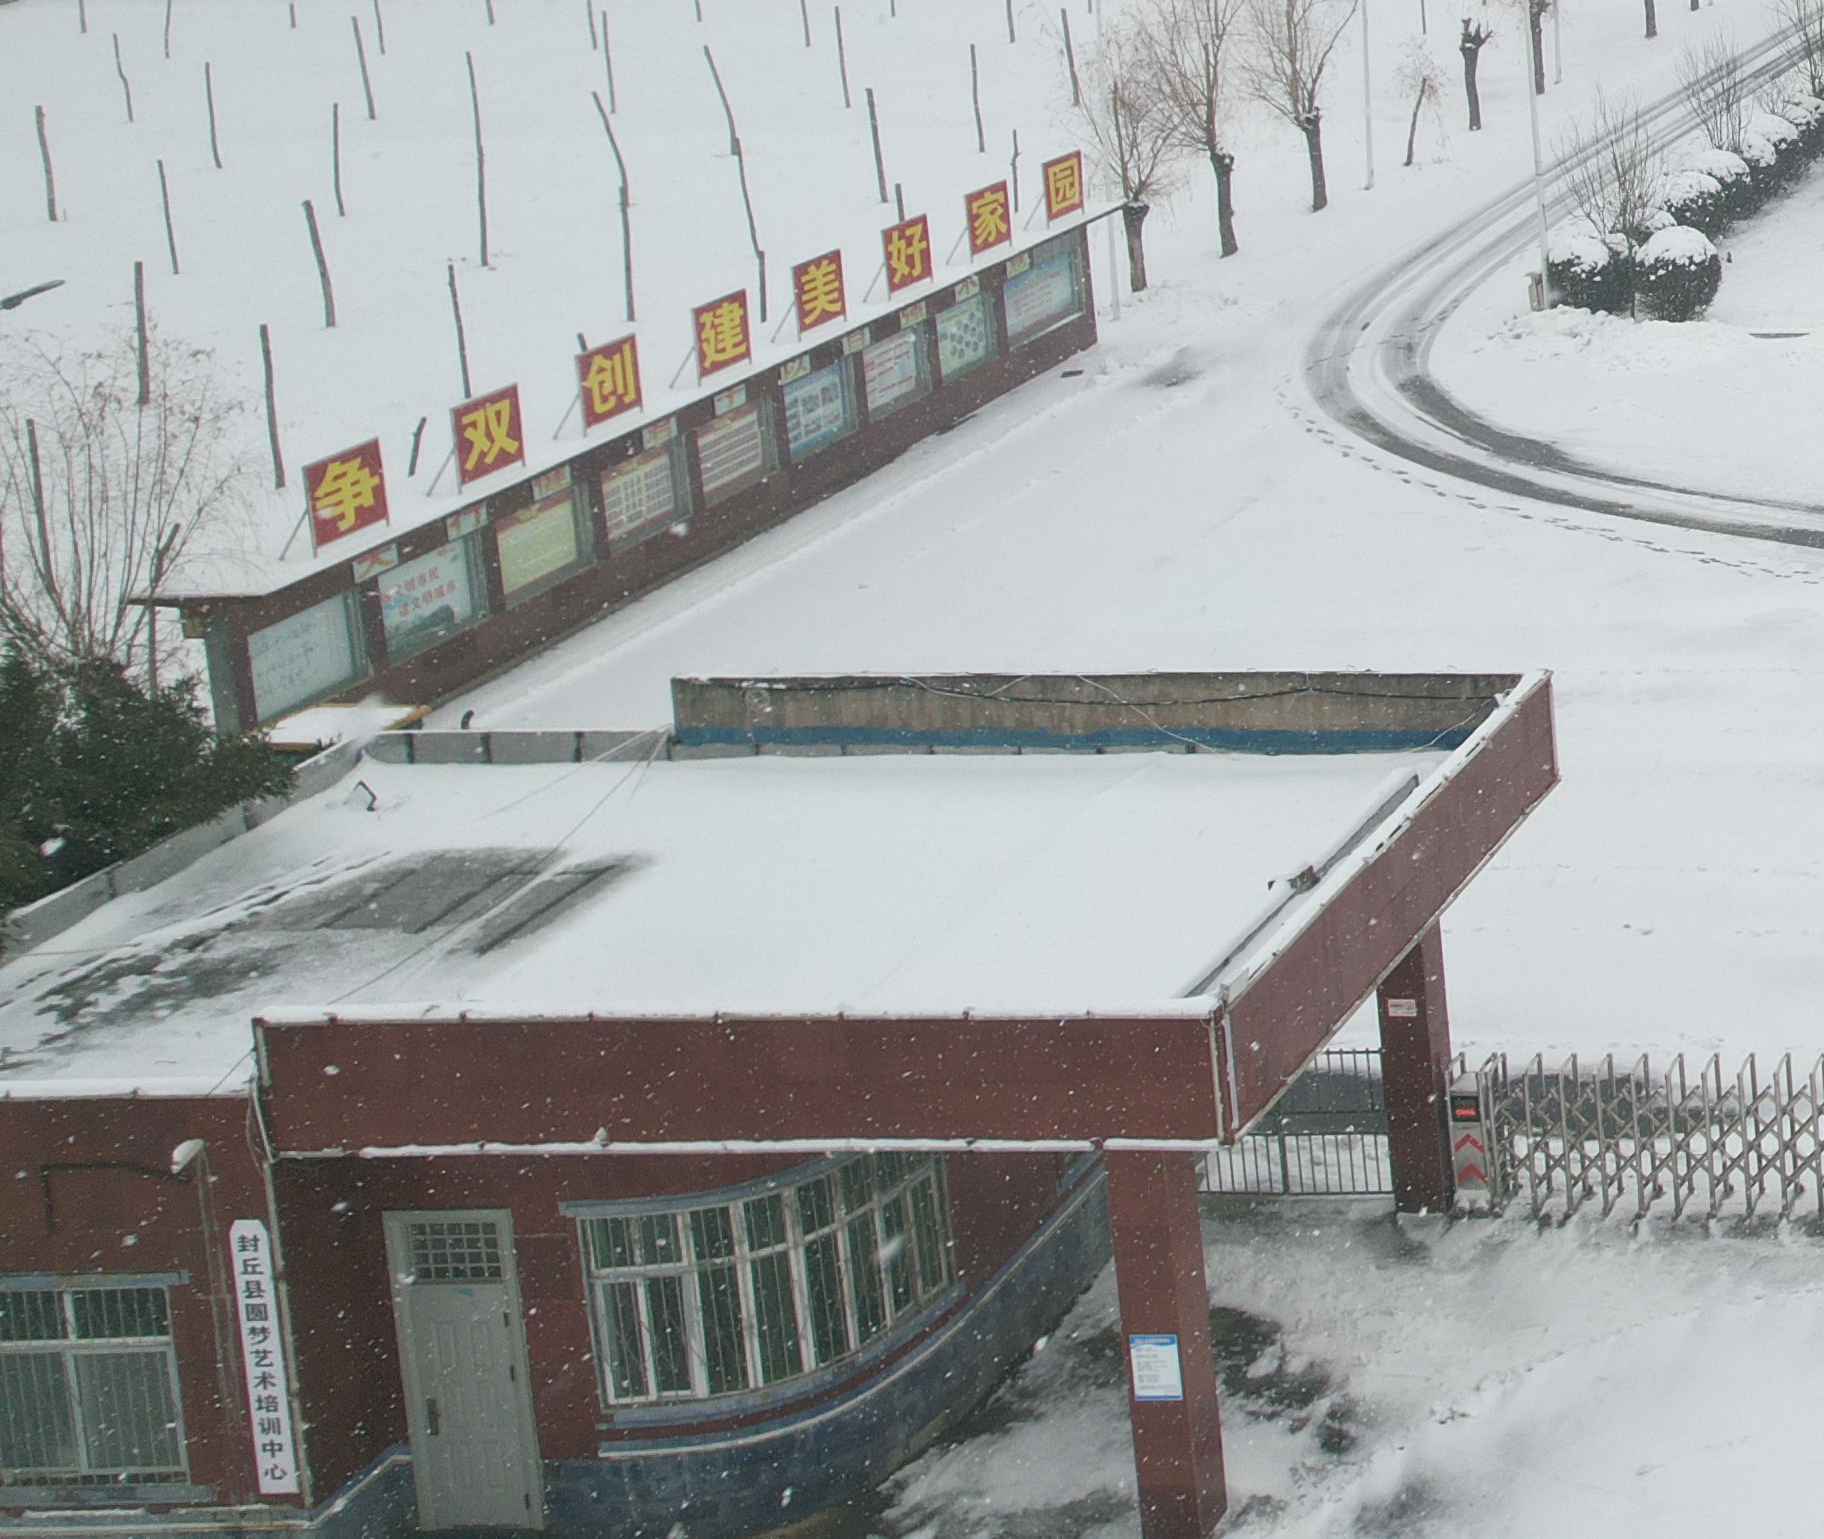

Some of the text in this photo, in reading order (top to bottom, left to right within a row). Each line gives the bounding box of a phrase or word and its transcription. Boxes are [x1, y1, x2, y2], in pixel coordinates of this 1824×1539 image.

[312, 154, 1081, 532] 争双创建美好家园
[237, 1233, 287, 1482] 封丘县圆梦艺术培训中心
